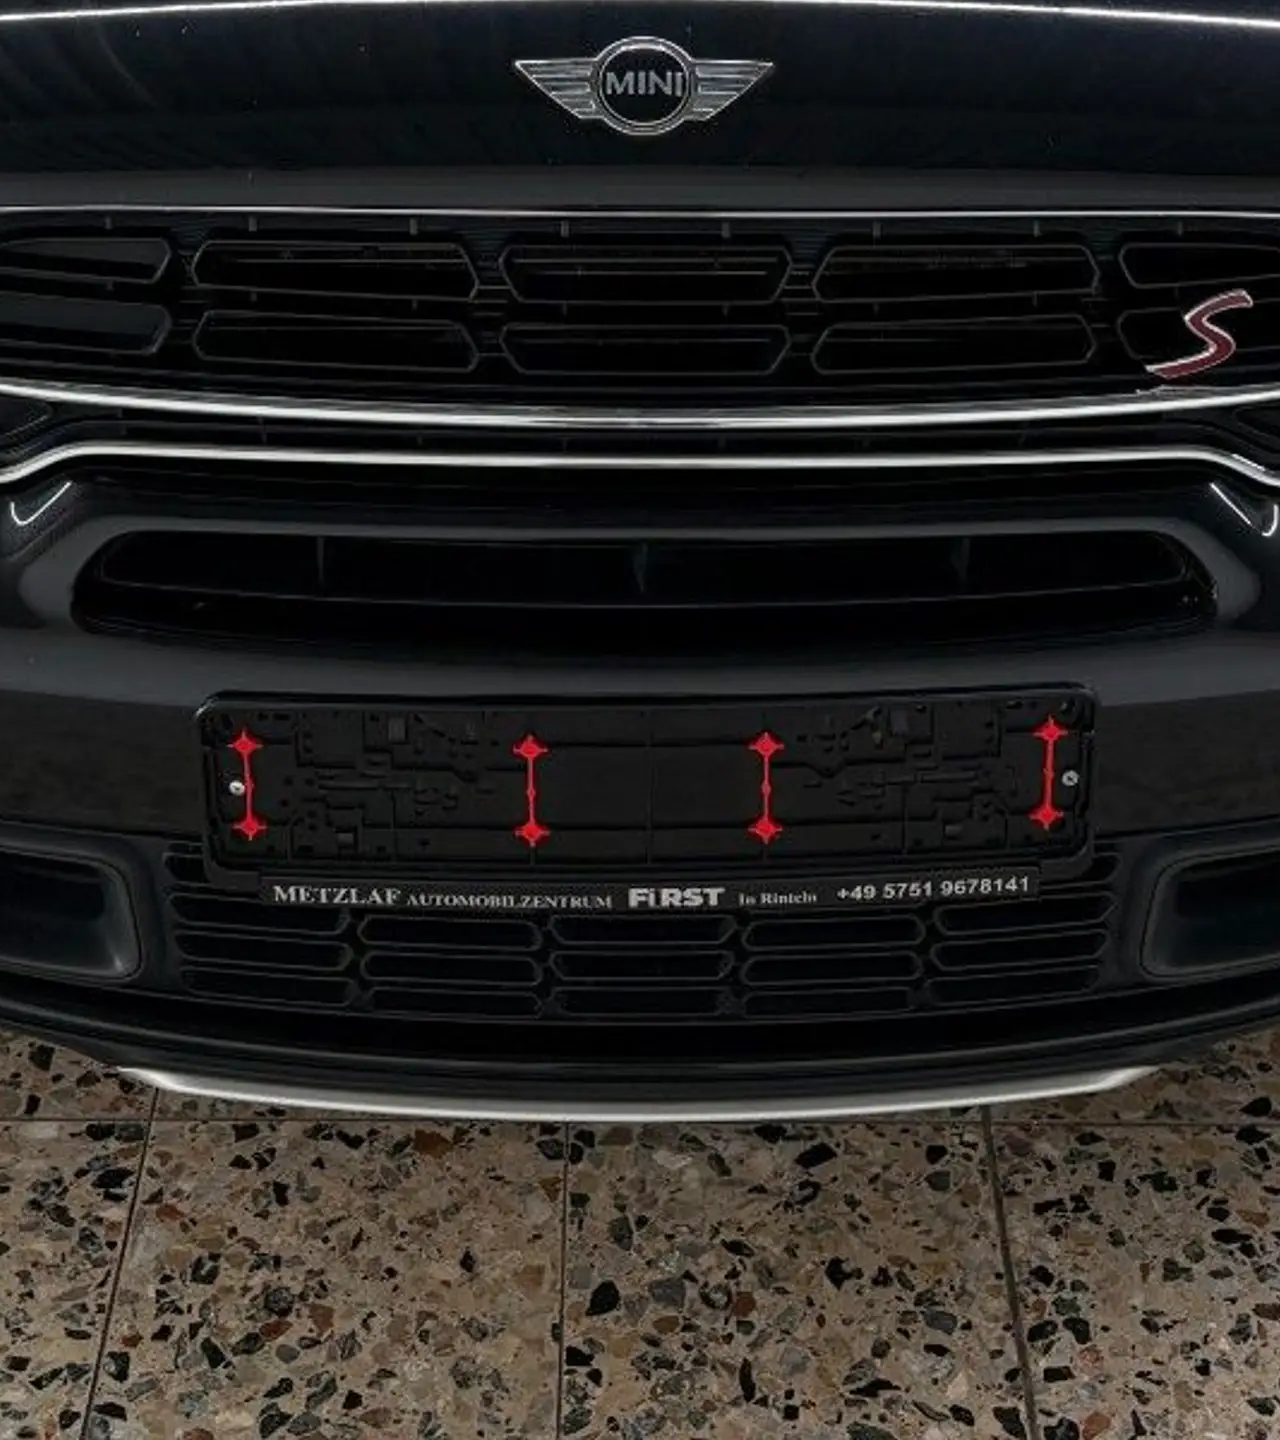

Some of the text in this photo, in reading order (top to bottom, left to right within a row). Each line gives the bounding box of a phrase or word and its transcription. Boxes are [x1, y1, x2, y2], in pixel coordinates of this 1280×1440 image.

[606, 70, 683, 97] MINI
[1145, 289, 1253, 380] S
[272, 885, 401, 905] METZLAF
[407, 890, 613, 909] AUTOMOBILZENTRUM
[837, 884, 876, 900] +49
[882, 880, 933, 900] 5751
[939, 875, 1029, 897] 9678141
